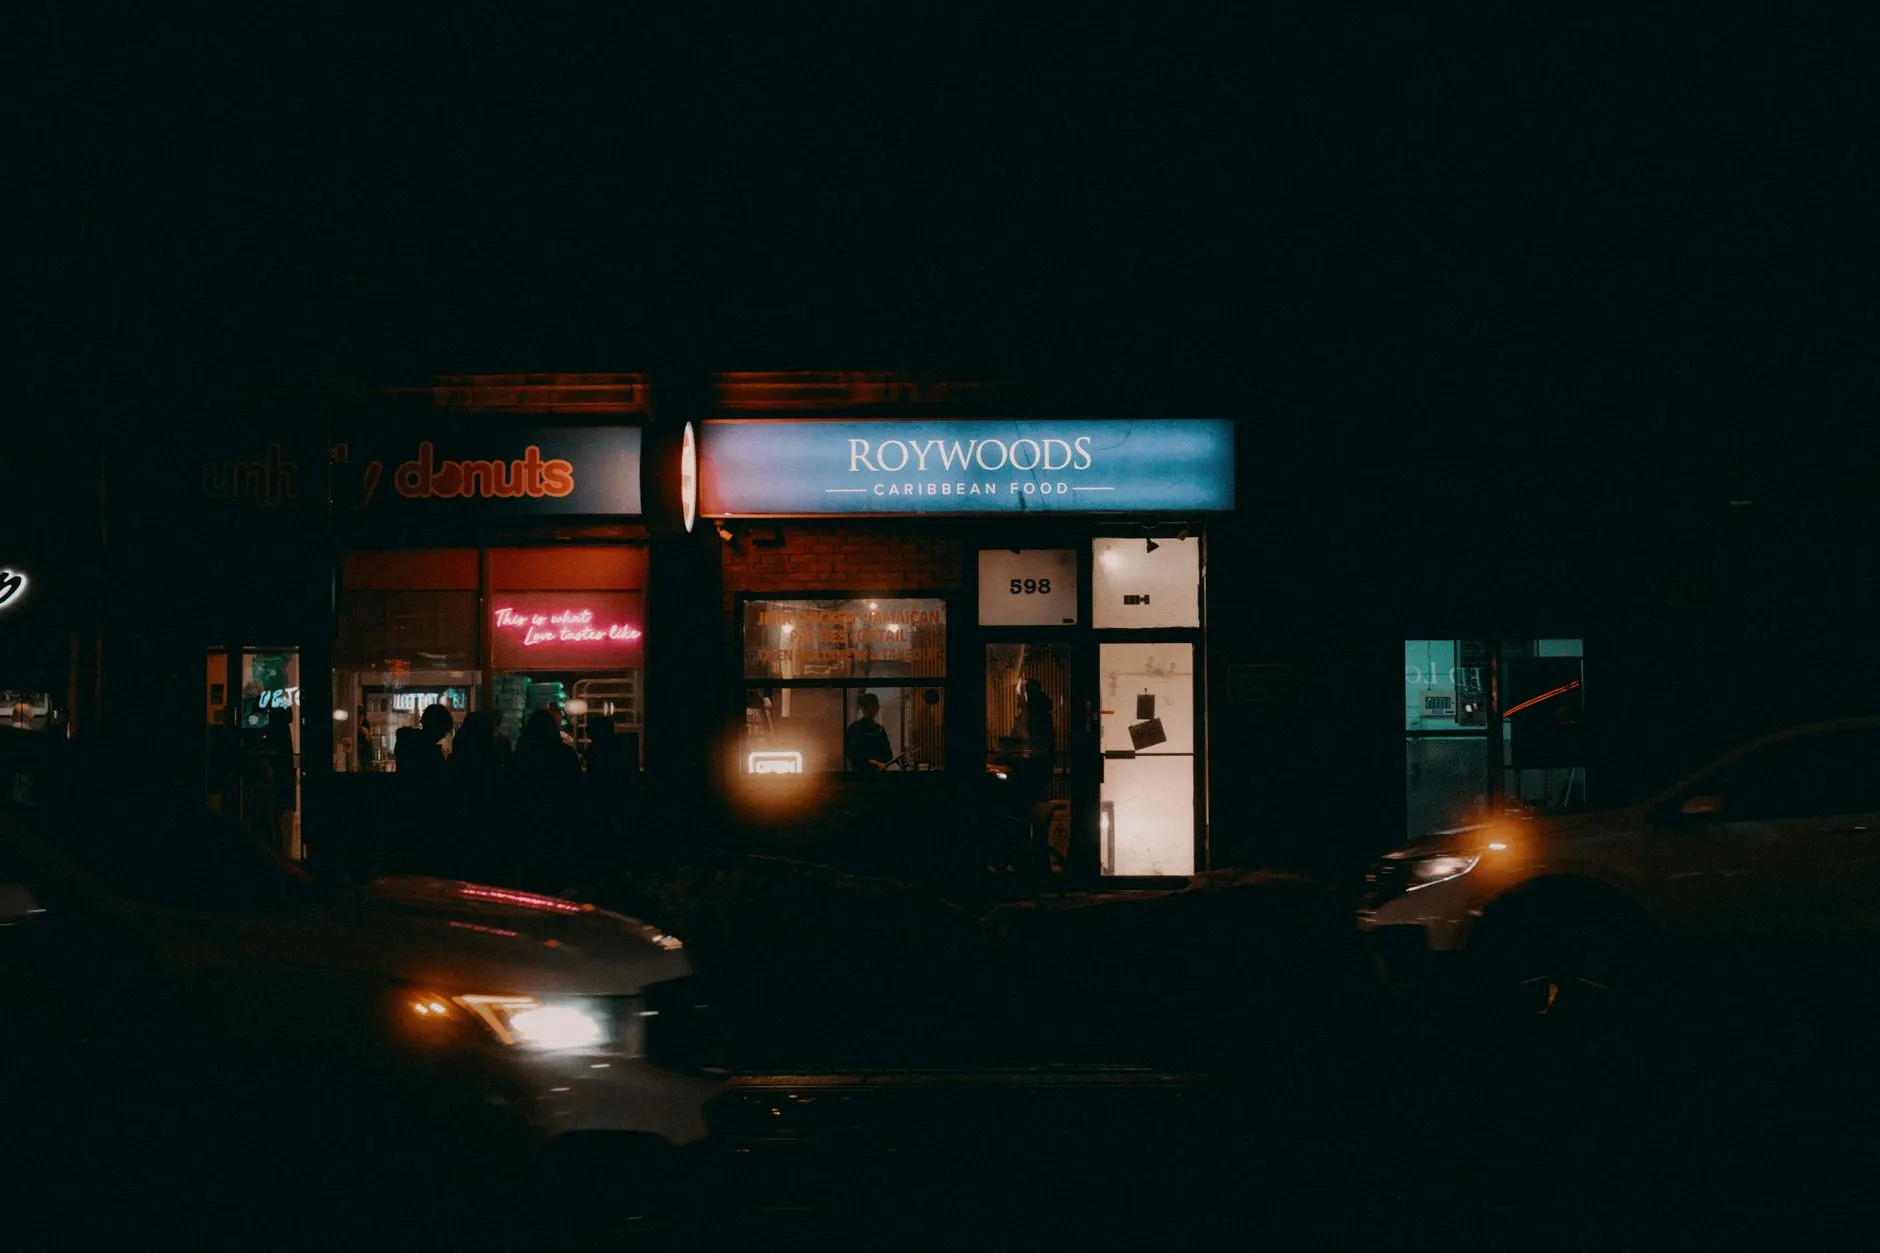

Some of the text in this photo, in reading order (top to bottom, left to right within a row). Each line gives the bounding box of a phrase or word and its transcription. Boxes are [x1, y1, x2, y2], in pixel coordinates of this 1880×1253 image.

[848, 436, 1092, 471] ROYWOODS
[394, 440, 576, 498] donuts
[873, 483, 1069, 496] CARIBBEAN FOOD
[1009, 578, 1051, 595] 598
[495, 608, 593, 628] This is what
[524, 624, 642, 646] Love tastes like
